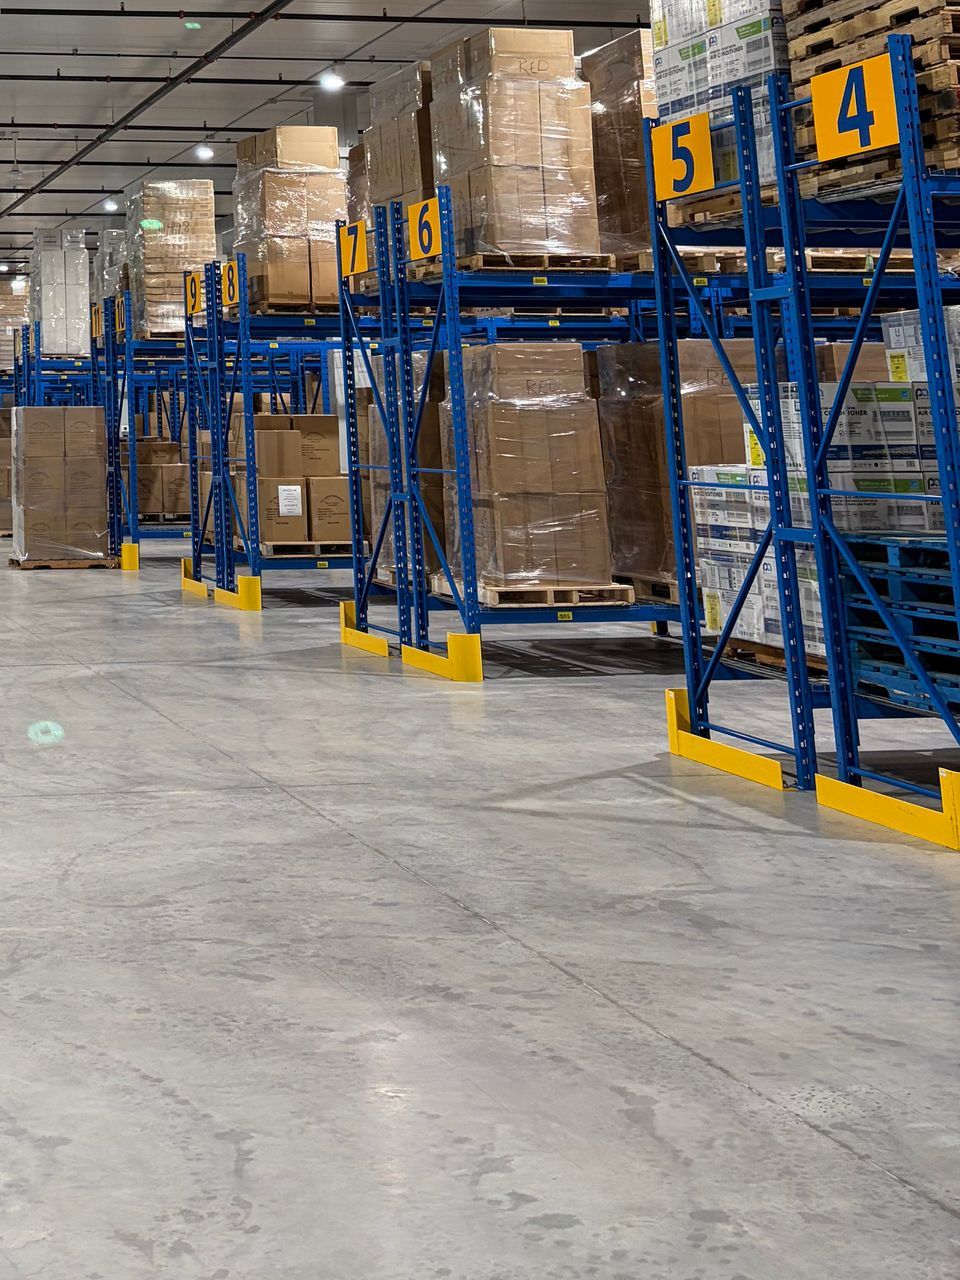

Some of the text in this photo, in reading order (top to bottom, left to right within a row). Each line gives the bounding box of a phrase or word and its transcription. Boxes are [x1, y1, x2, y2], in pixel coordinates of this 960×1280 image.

[837, 65, 875, 148] 4
[671, 121, 695, 193] 5
[347, 225, 358, 272] 7
[418, 203, 433, 255] 6
[190, 277, 197, 311] 9
[228, 265, 235, 302] 8
[117, 300, 125, 328] 10
